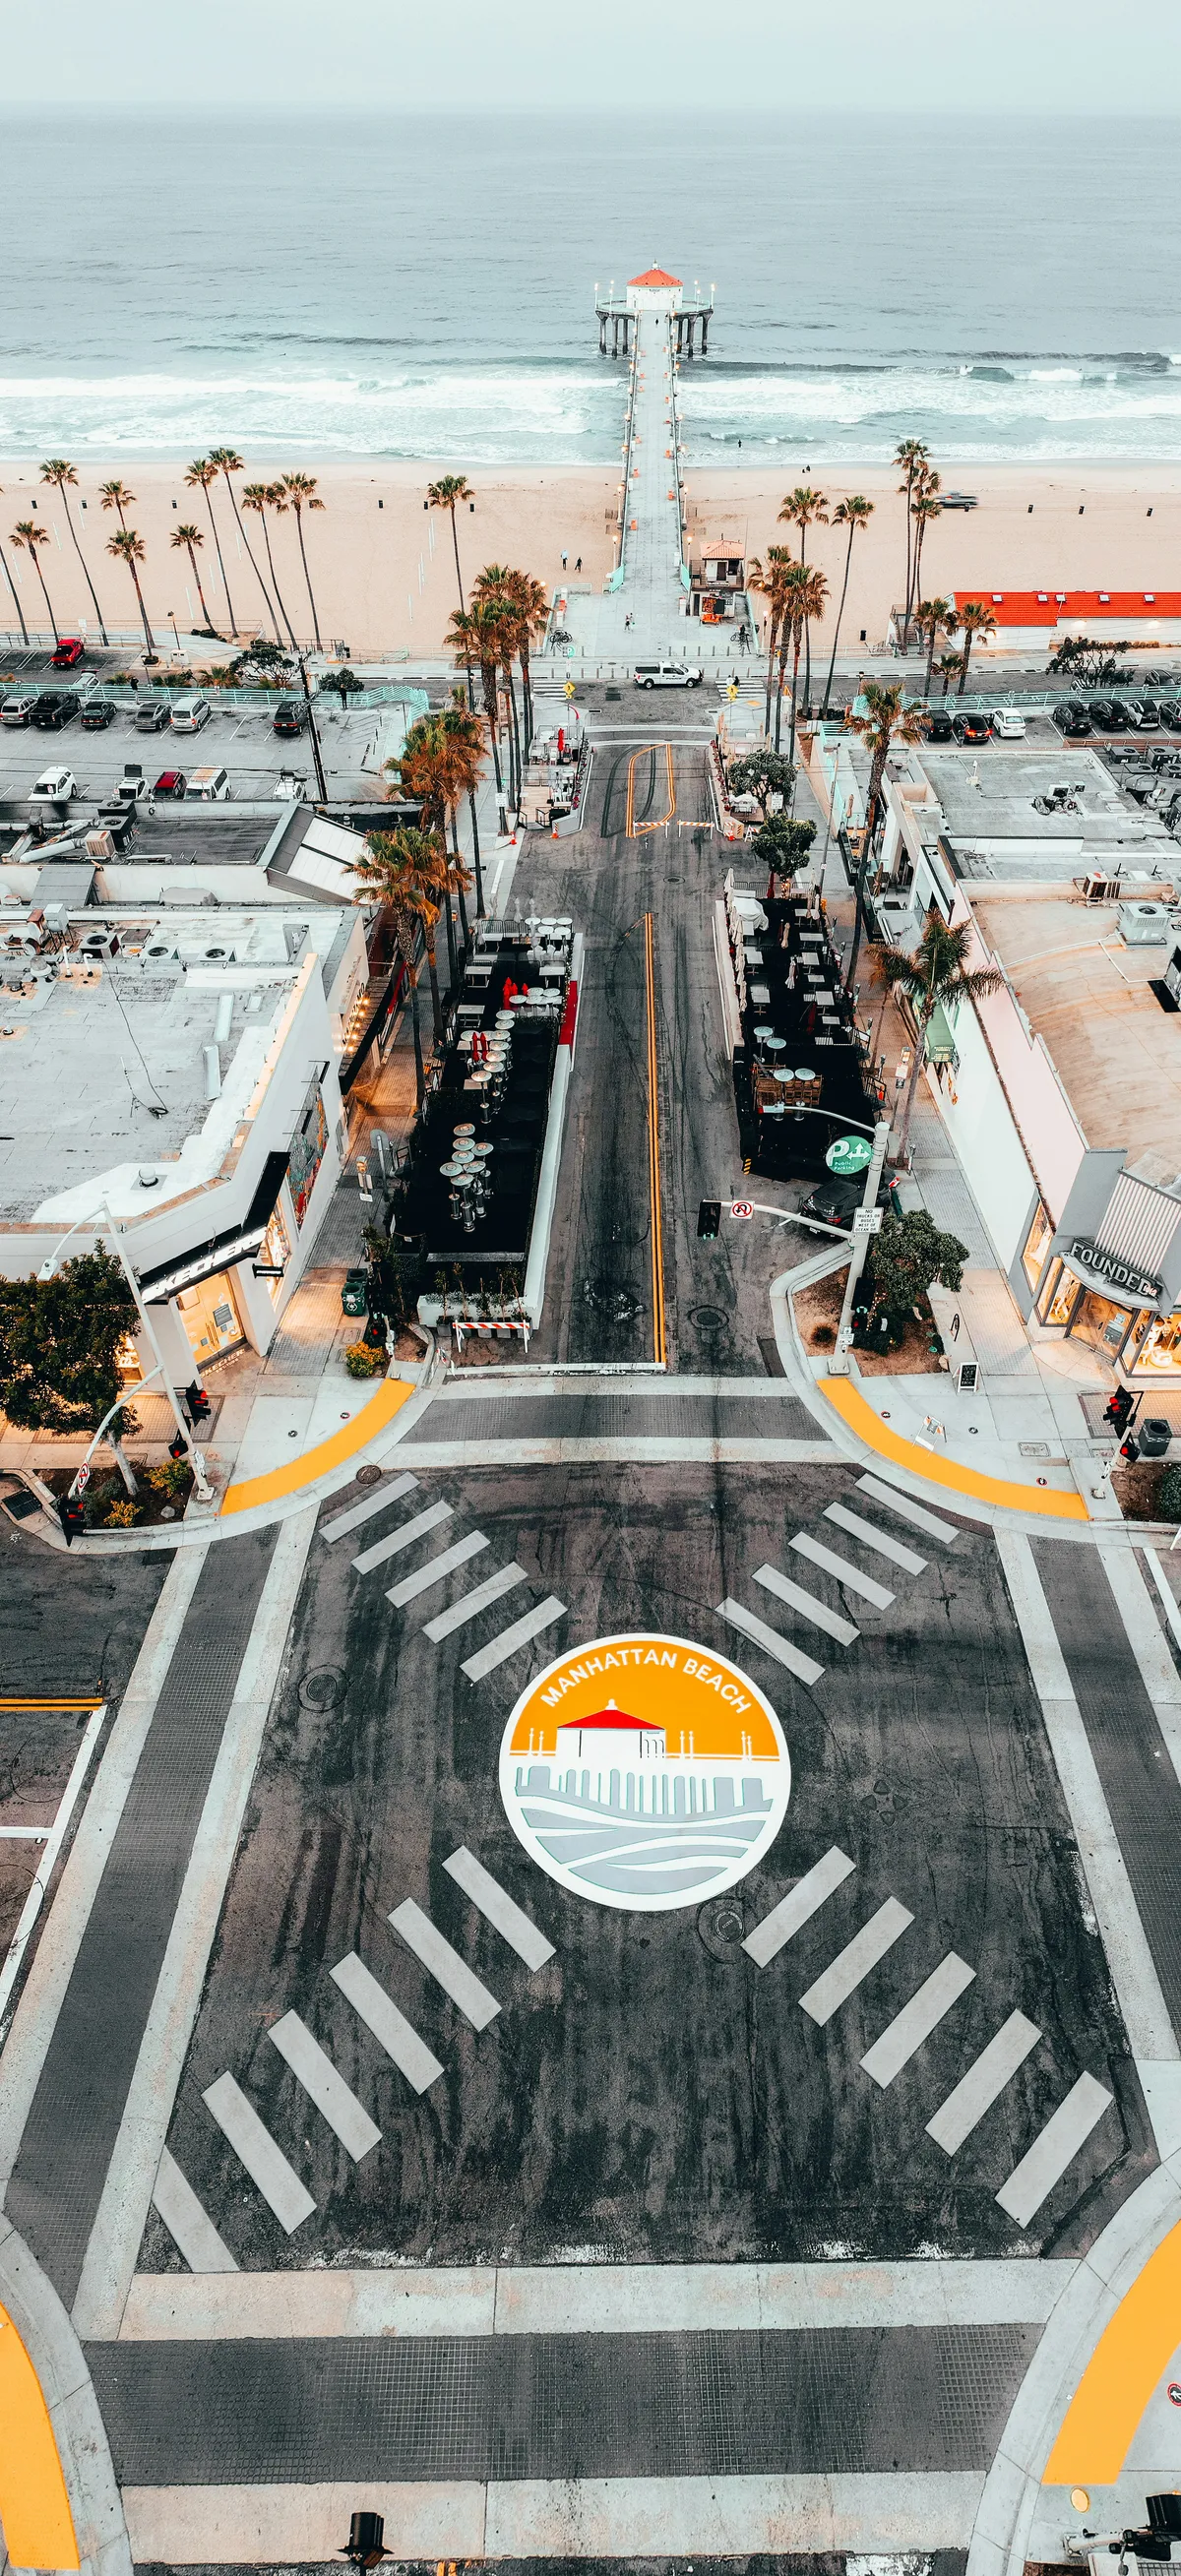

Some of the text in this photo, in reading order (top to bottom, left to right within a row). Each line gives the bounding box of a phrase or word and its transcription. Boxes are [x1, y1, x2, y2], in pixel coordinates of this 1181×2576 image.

[826, 1139, 849, 1166] P
[141, 1226, 267, 1304] SKECHERS
[540, 1648, 752, 1715] MANHATTAN BEACH
